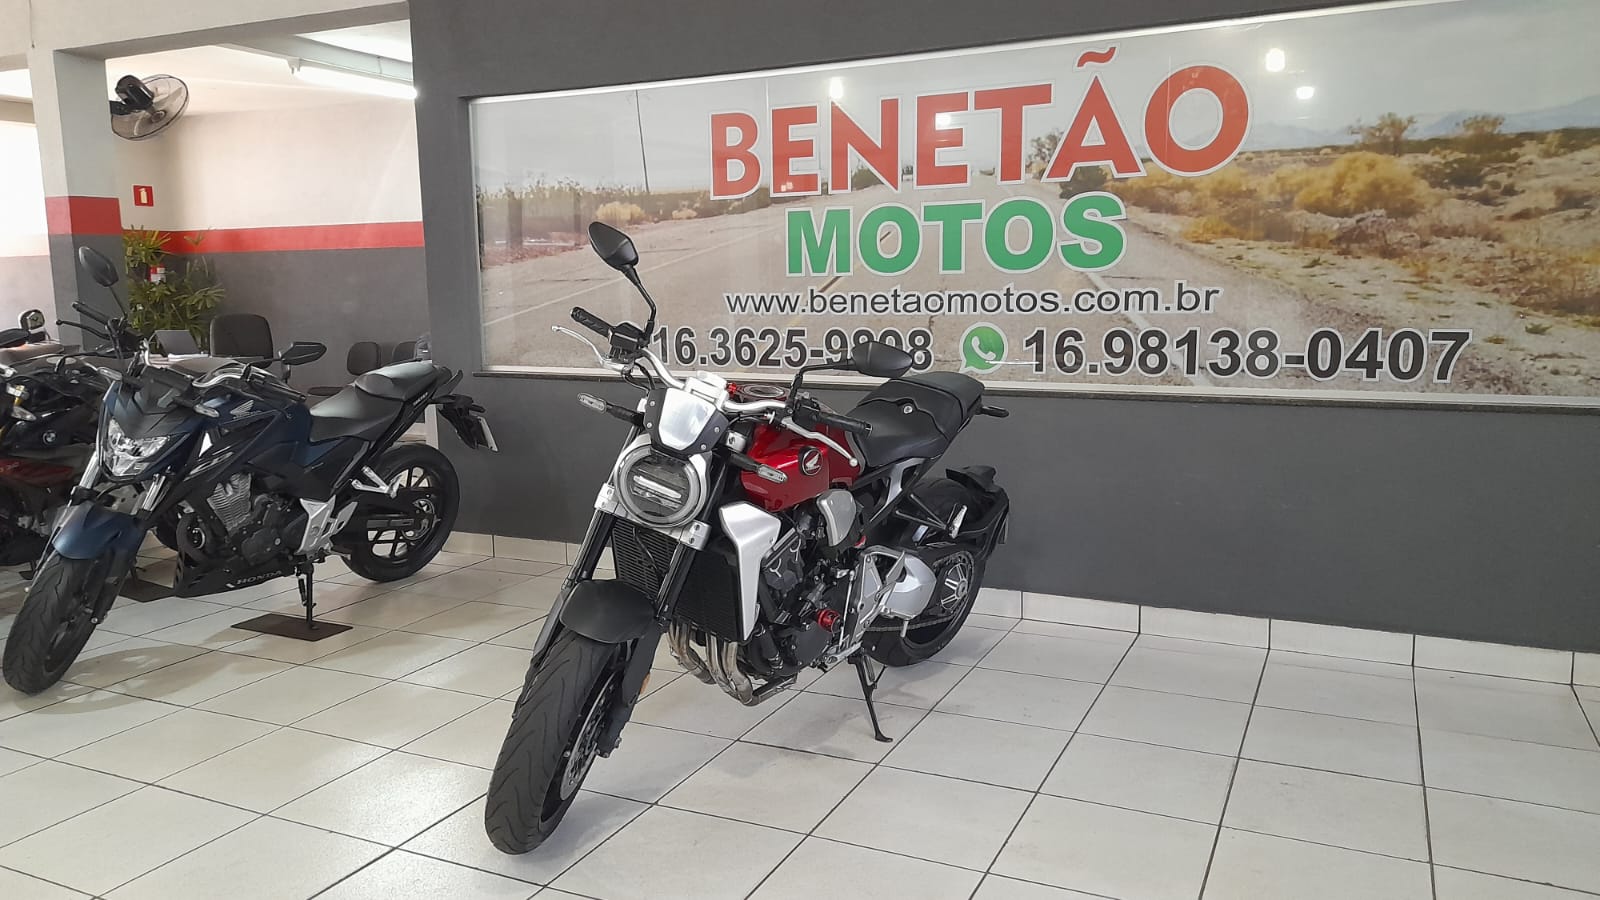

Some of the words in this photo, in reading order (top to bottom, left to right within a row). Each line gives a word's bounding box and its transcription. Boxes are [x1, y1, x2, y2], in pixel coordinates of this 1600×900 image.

[710, 46, 1250, 198] BENETÃO
[786, 193, 1126, 275] MOTOS
[725, 282, 1221, 314] www.benetaomotos.com.br
[1024, 327, 1470, 382] 16.98138-0407
